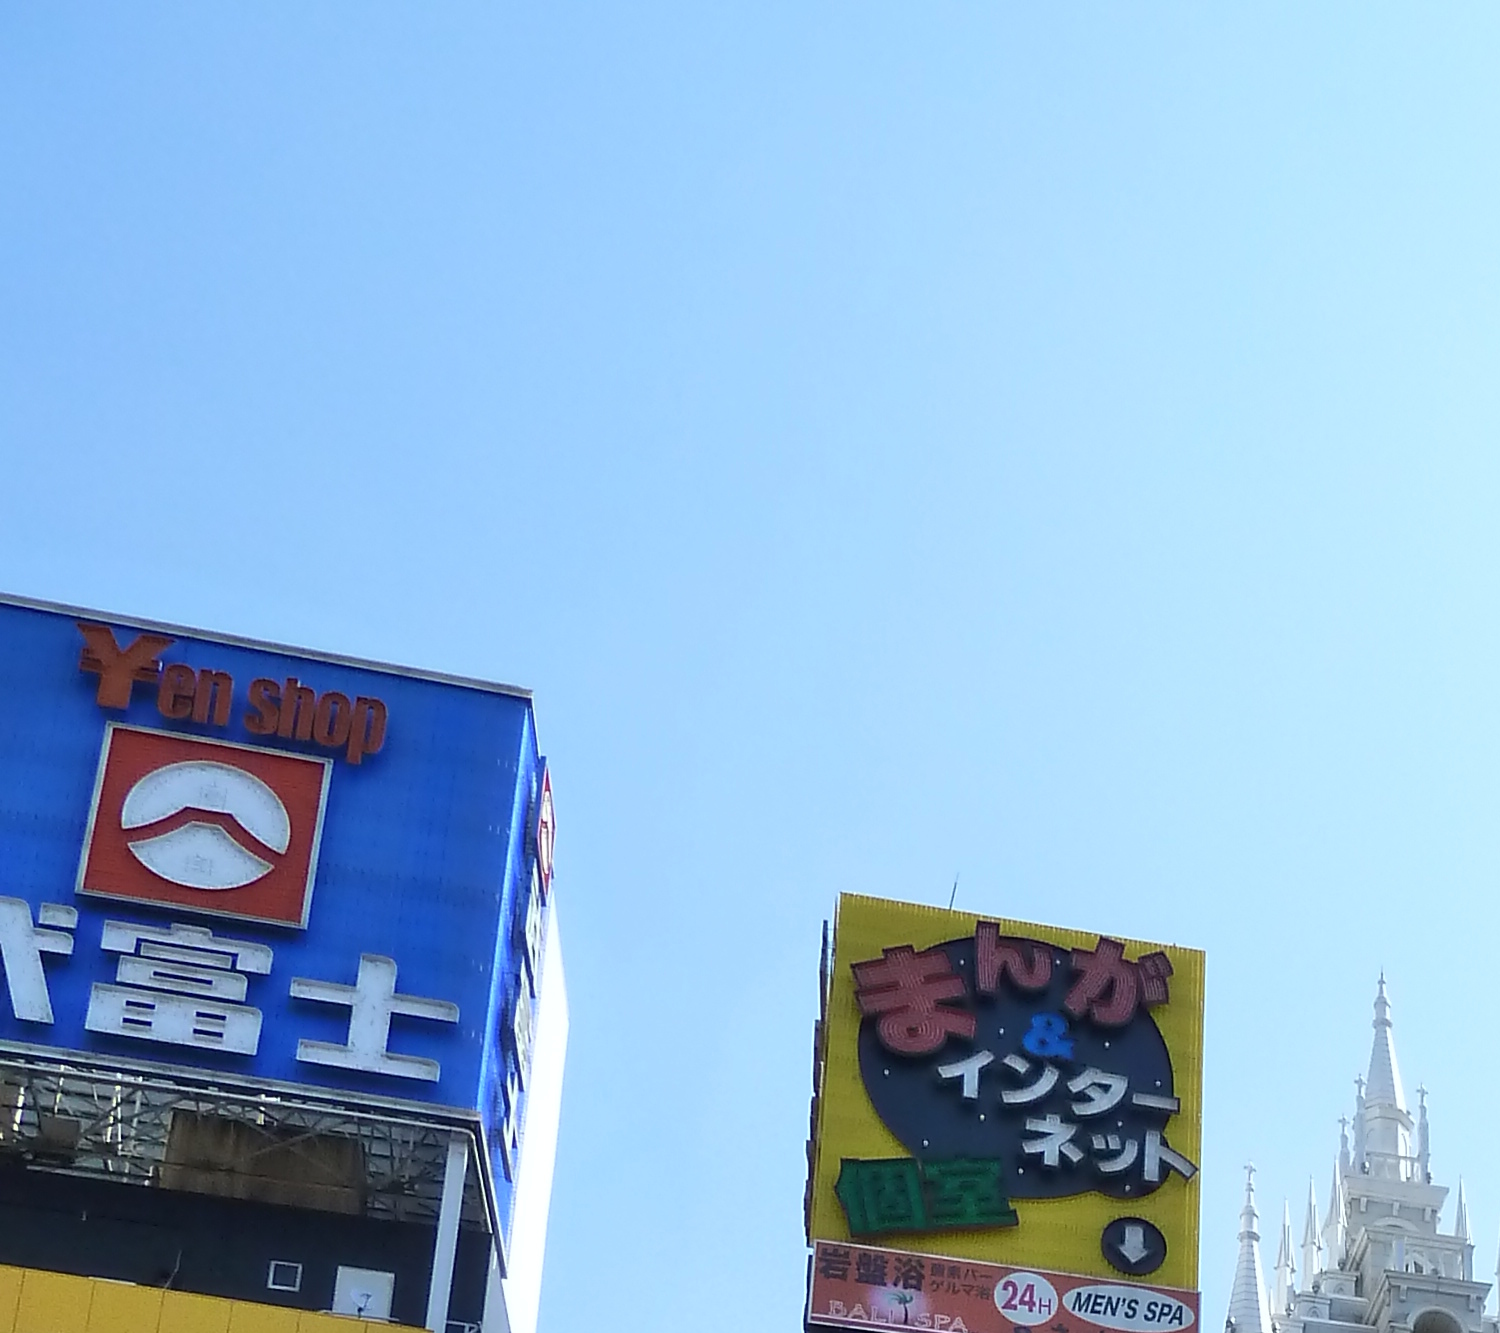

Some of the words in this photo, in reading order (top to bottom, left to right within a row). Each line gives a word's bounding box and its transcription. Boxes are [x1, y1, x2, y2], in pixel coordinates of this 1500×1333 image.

[244, 676, 390, 765] shop
[850, 920, 1174, 1058] まんが
[1022, 1011, 1075, 1060] &
[937, 1049, 1182, 1117] インター
[1022, 1113, 1199, 1184] ネット
[834, 1156, 1020, 1238] 個室
[818, 1247, 926, 1292] 岩盤浴
[1000, 1280, 1053, 1316] 24H
[828, 1299, 897, 1324] BALI
[914, 1312, 969, 1333] SPA
[1143, 1300, 1185, 1326] SPA
